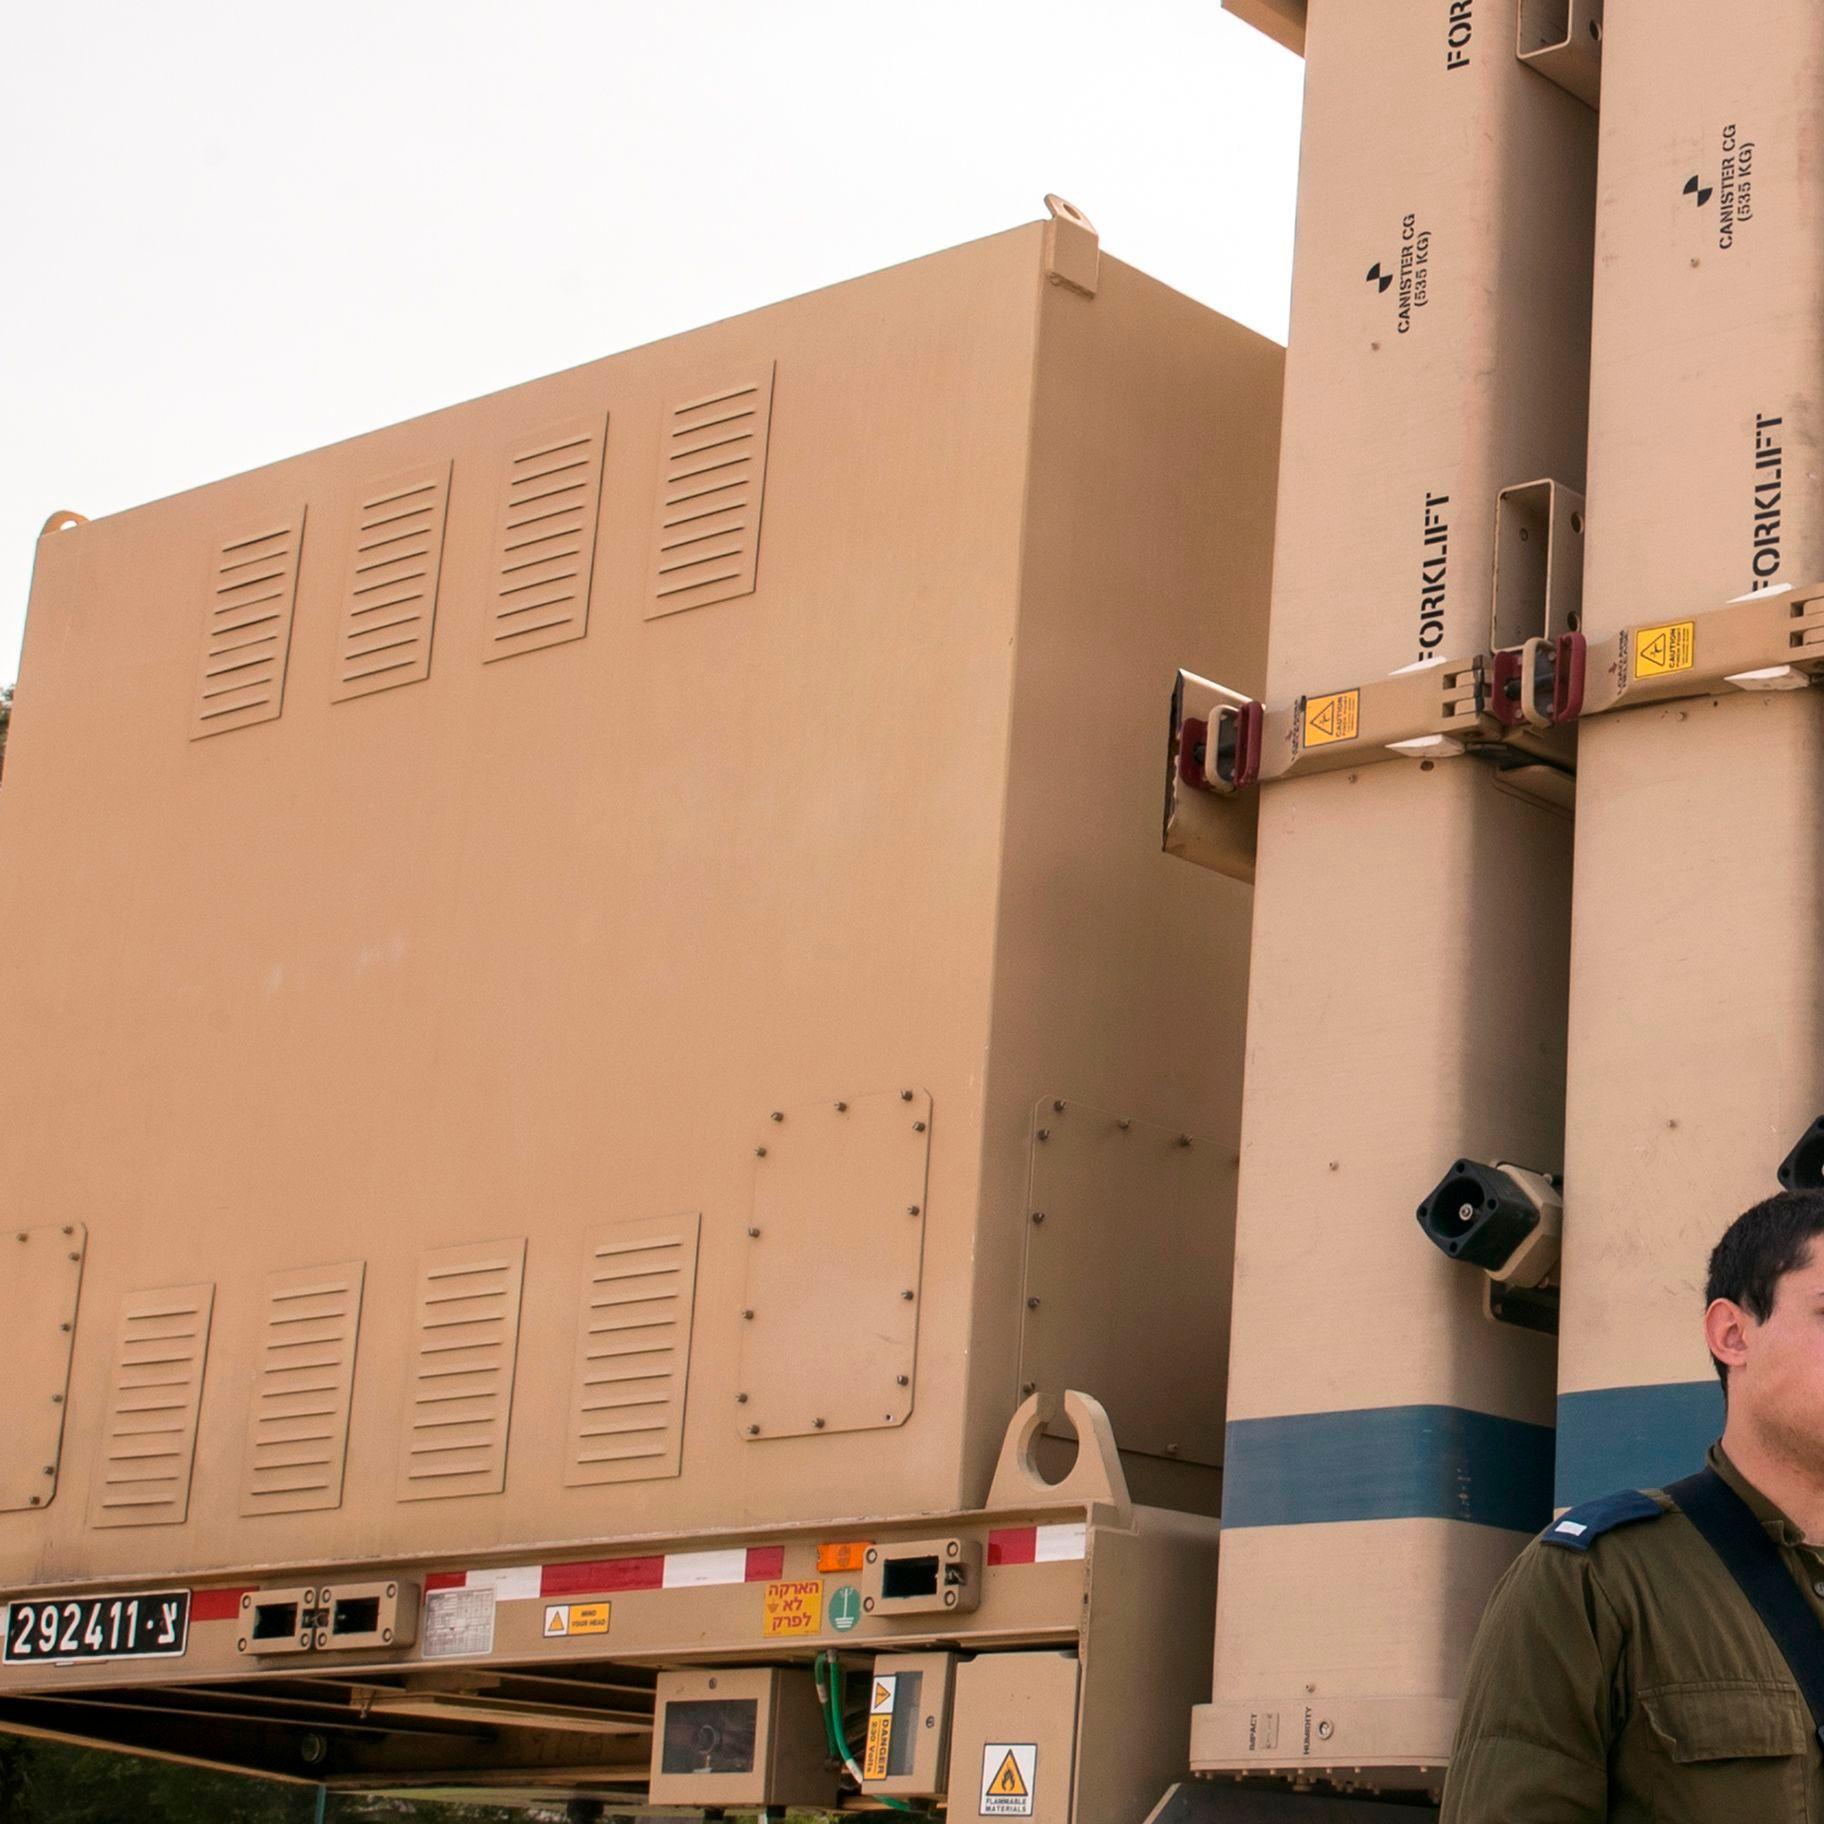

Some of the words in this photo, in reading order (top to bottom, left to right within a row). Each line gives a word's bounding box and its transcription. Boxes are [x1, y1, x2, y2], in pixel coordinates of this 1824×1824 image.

[1722, 123, 1737, 153] CG
[1738, 141, 1755, 176] KG)
[1719, 157, 1735, 249] CANISTER
[1737, 180, 1753, 222] (535
[1401, 213, 1416, 243] CG
[1416, 229, 1432, 262] KG)
[1397, 245, 1413, 333] CANISTER
[1414, 264, 1430, 308] (535
[1335, 696, 1343, 737] CAUTION
[768, 1582, 819, 1598] הארקה
[783, 1596, 803, 1611] לא
[772, 1612, 812, 1631] לפרק
[877, 1719, 889, 1774] DANGER
[1249, 1713, 1258, 1751] IMPACT
[1303, 1706, 1312, 1754] HUMIDITY
